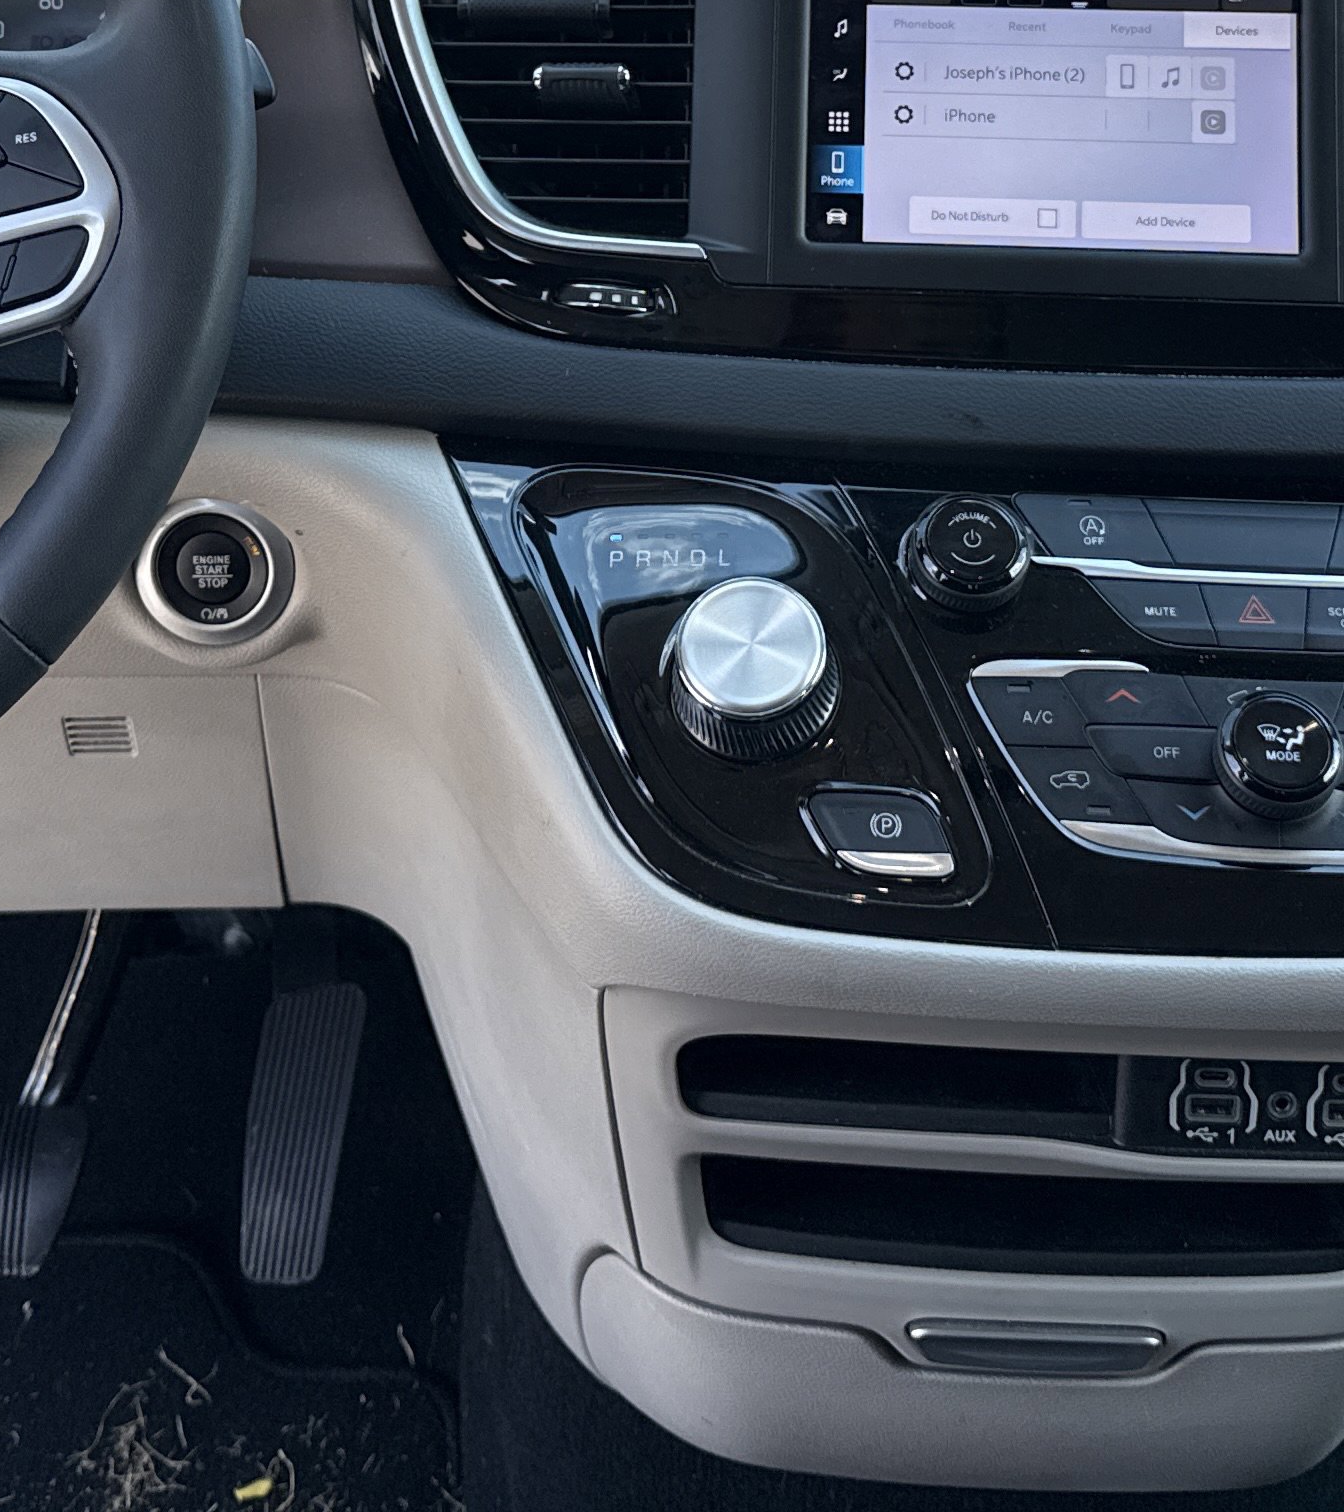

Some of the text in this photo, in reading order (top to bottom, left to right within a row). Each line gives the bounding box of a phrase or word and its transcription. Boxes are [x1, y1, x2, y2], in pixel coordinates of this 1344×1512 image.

[894, 19, 955, 30] Phonebook
[1008, 22, 1046, 32] Recent
[1110, 23, 1152, 36] Keypad
[1216, 25, 1258, 36] Devices
[944, 66, 1085, 84] Joseph's iPhone (2)
[944, 108, 996, 123] iPhone
[14, 132, 38, 144] RES
[821, 176, 854, 186] Phone
[931, 210, 1009, 222] Do Not Disturb
[1136, 216, 1196, 228] Add Device
[952, 511, 990, 524] VOLUME
[1083, 536, 1105, 546] OFF
[192, 555, 231, 565] ENGINE
[610, 549, 731, 568] P R N D L
[194, 565, 230, 574] START
[198, 578, 229, 588] STOP
[1144, 606, 1177, 618] MUTE
[1022, 710, 1053, 724] A/C
[1153, 747, 1181, 759] OFF
[1265, 750, 1302, 763] MODE
[1226, 1128, 1235, 1145] 1
[1264, 1130, 1296, 1144] AUX
